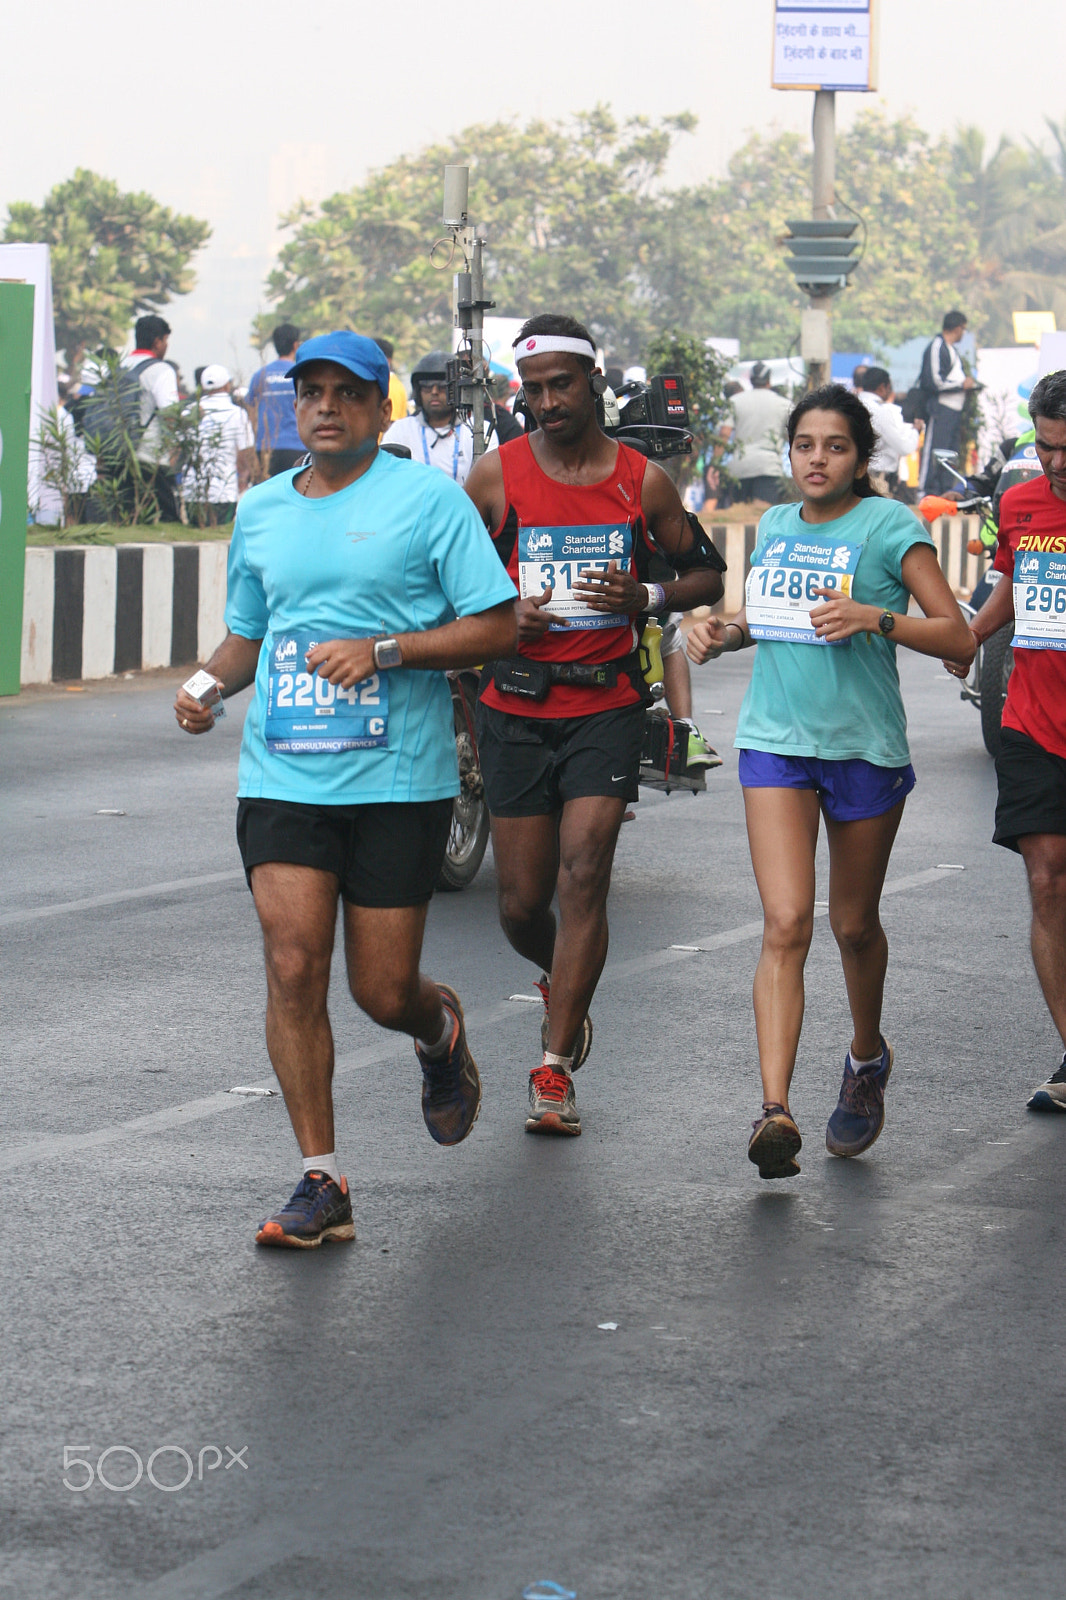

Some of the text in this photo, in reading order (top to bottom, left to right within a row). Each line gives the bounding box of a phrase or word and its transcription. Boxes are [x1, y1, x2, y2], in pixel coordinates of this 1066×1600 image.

[809, 23, 819, 37] के
[817, 45, 827, 60] के
[830, 47, 848, 60] बाद
[850, 45, 863, 60] भी
[565, 534, 606, 545] Standard
[561, 545, 606, 555] Chartered
[793, 543, 832, 556] Standard
[788, 553, 830, 565] Chartered
[597, 617, 621, 626] SERVICES
[750, 628, 765, 636] TATA
[766, 629, 811, 641] CONSULTANCY
[1017, 638, 1029, 646] TATA
[277, 673, 380, 707] 22042
[369, 718, 384, 736] C
[291, 741, 342, 750] CONSULTANCY
[343, 740, 377, 749] SERVICES
